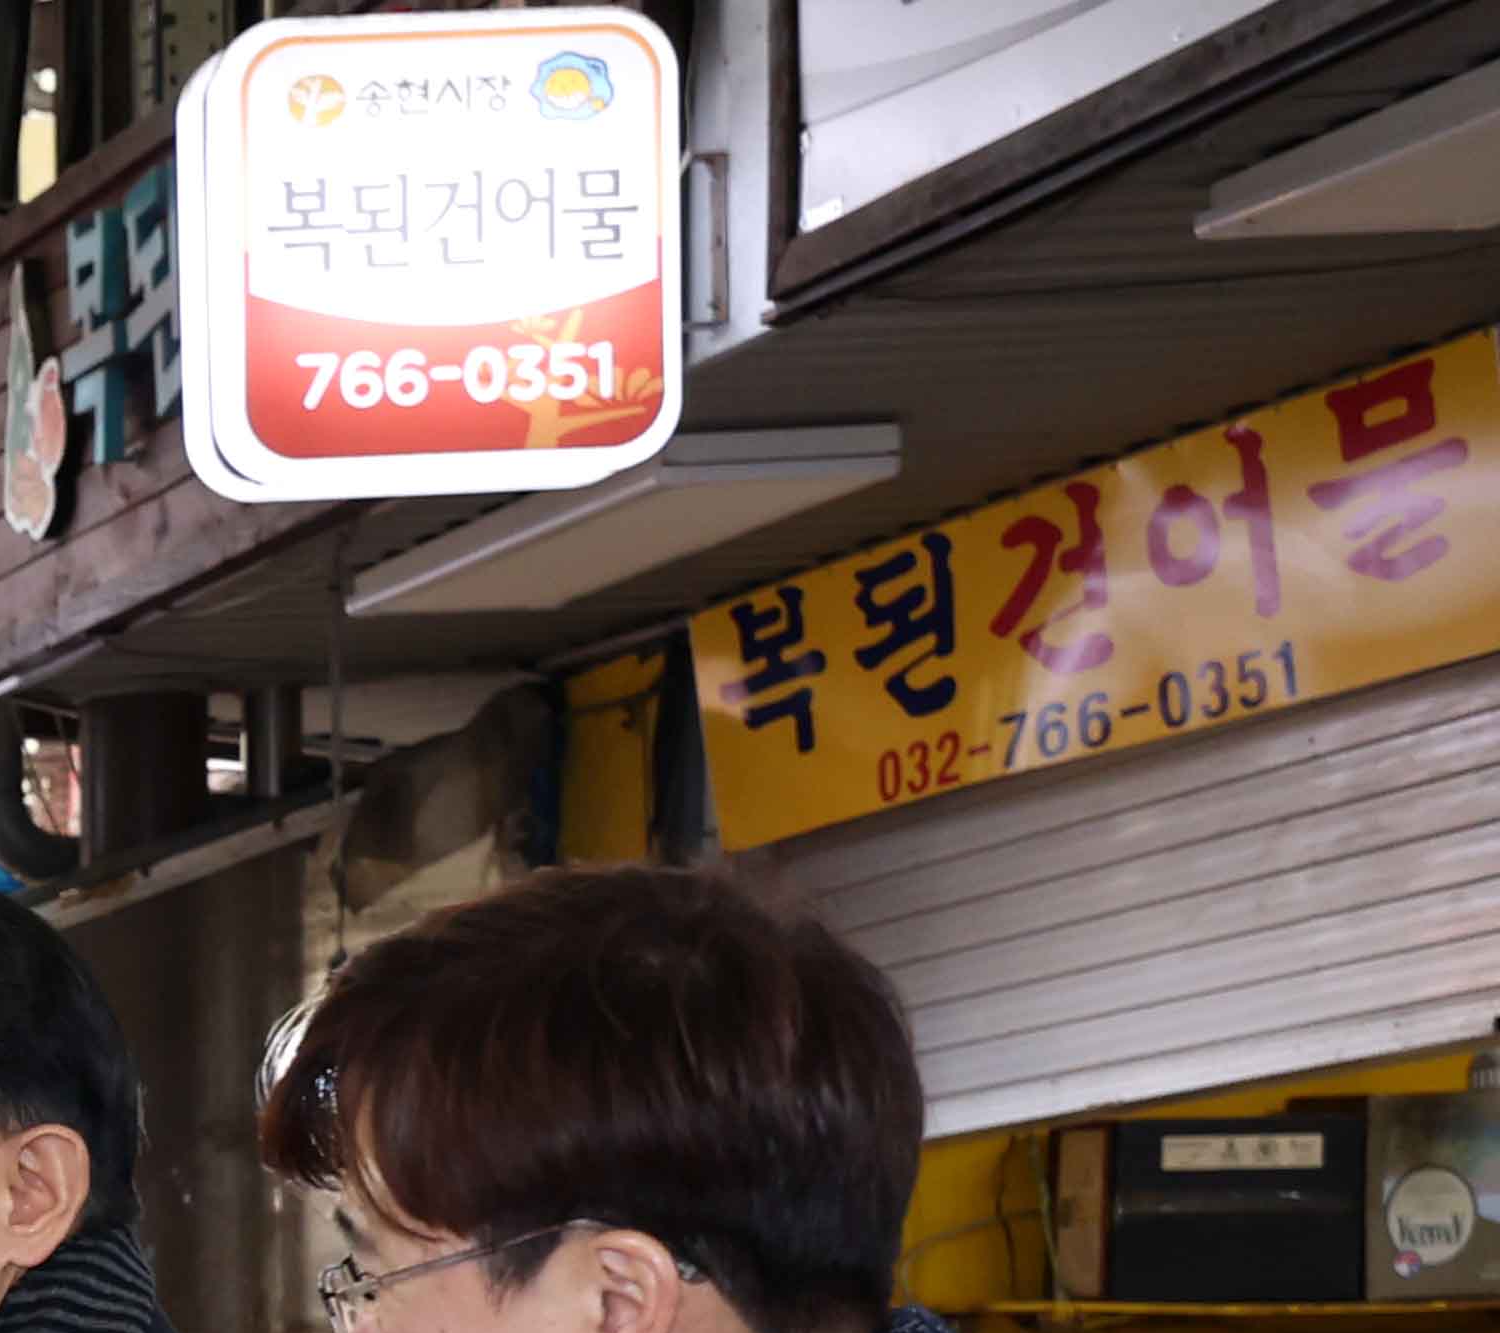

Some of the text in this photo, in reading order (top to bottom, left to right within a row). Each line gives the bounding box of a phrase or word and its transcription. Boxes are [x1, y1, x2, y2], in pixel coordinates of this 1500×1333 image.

[355, 73, 512, 119] 송현시장
[267, 168, 640, 271] 복된건어물
[295, 341, 616, 412] 766-0351
[876, 639, 1302, 804] 032-766-0351
